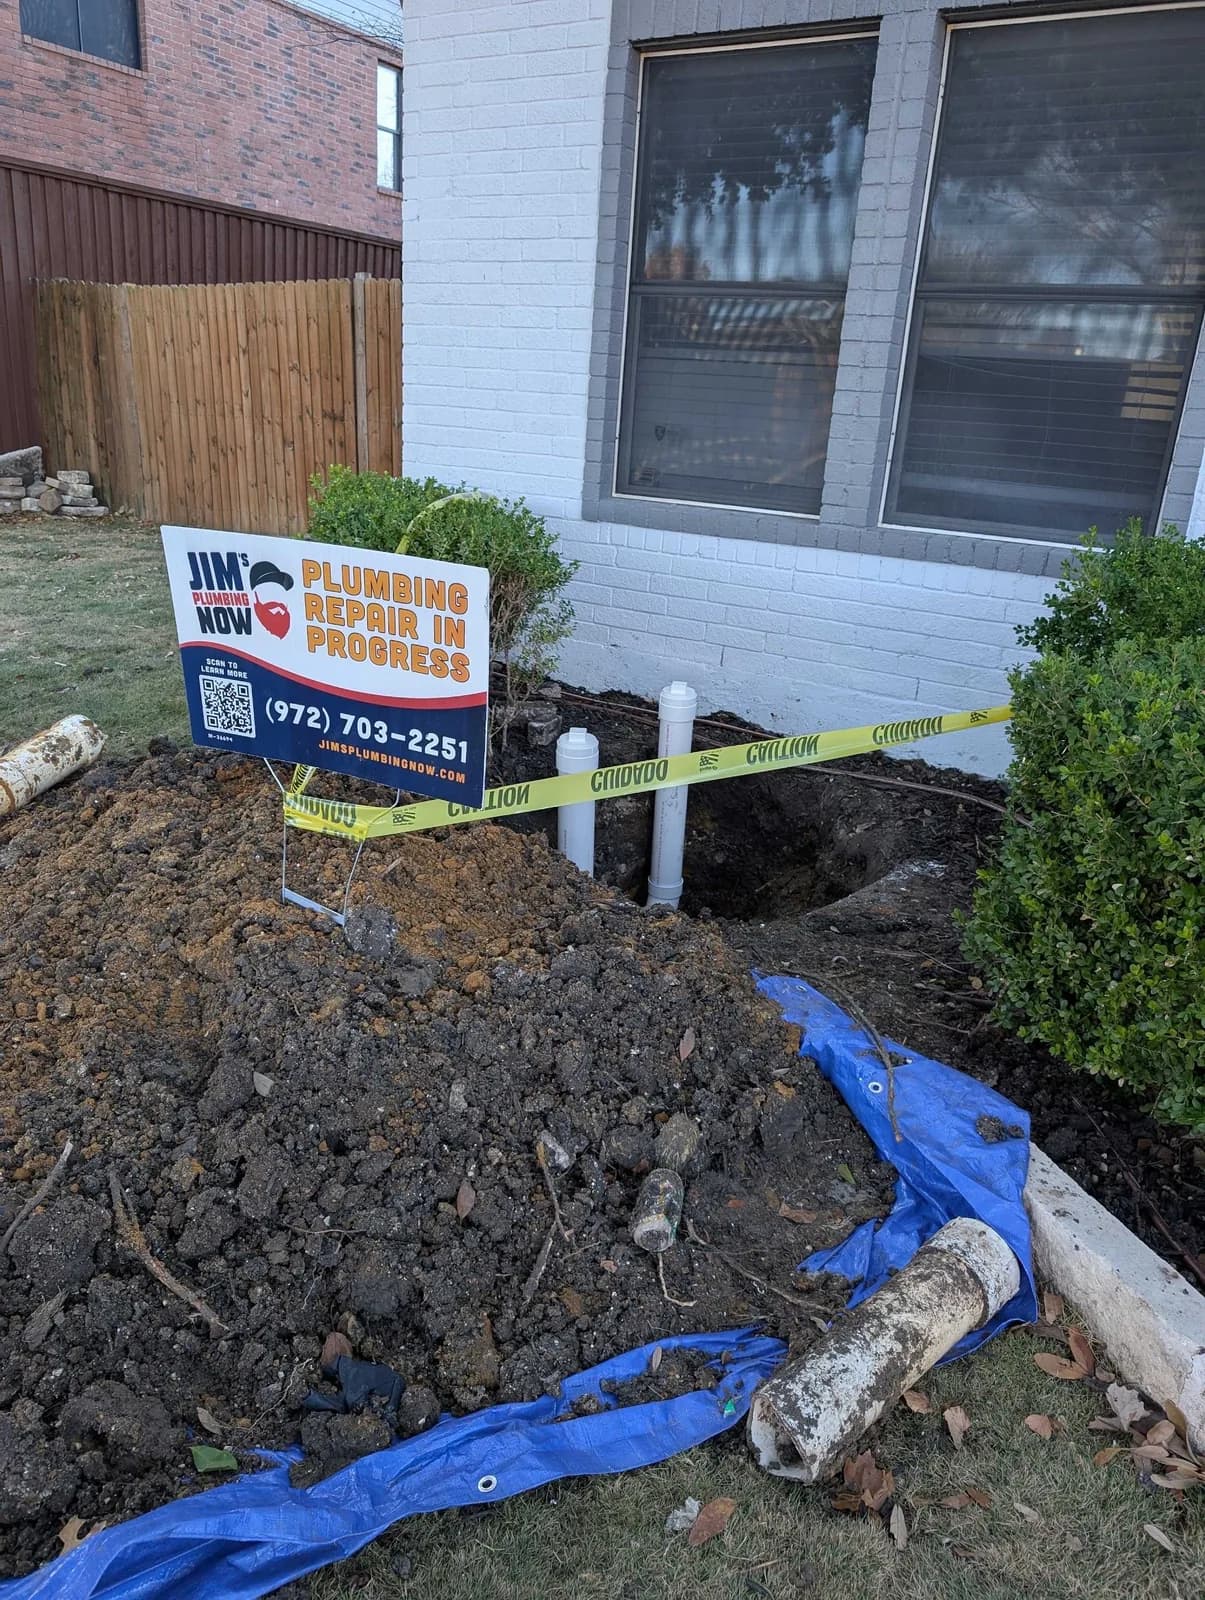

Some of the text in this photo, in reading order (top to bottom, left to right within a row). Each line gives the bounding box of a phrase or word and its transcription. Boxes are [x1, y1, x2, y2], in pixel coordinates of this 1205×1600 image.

[187, 551, 250, 591] JIM'S
[302, 559, 469, 615] PLUMBING
[192, 591, 250, 607] PLUMBING
[196, 606, 252, 635] NOW
[304, 592, 466, 649] REPAIR IN
[201, 665, 248, 679] LEARN MORE
[206, 658, 238, 669] SCAN TO
[306, 625, 471, 683] PROGRESS
[265, 697, 468, 763] (972) 703-2251
[318, 739, 466, 784] JIMSPLUMBINGNOW.COM
